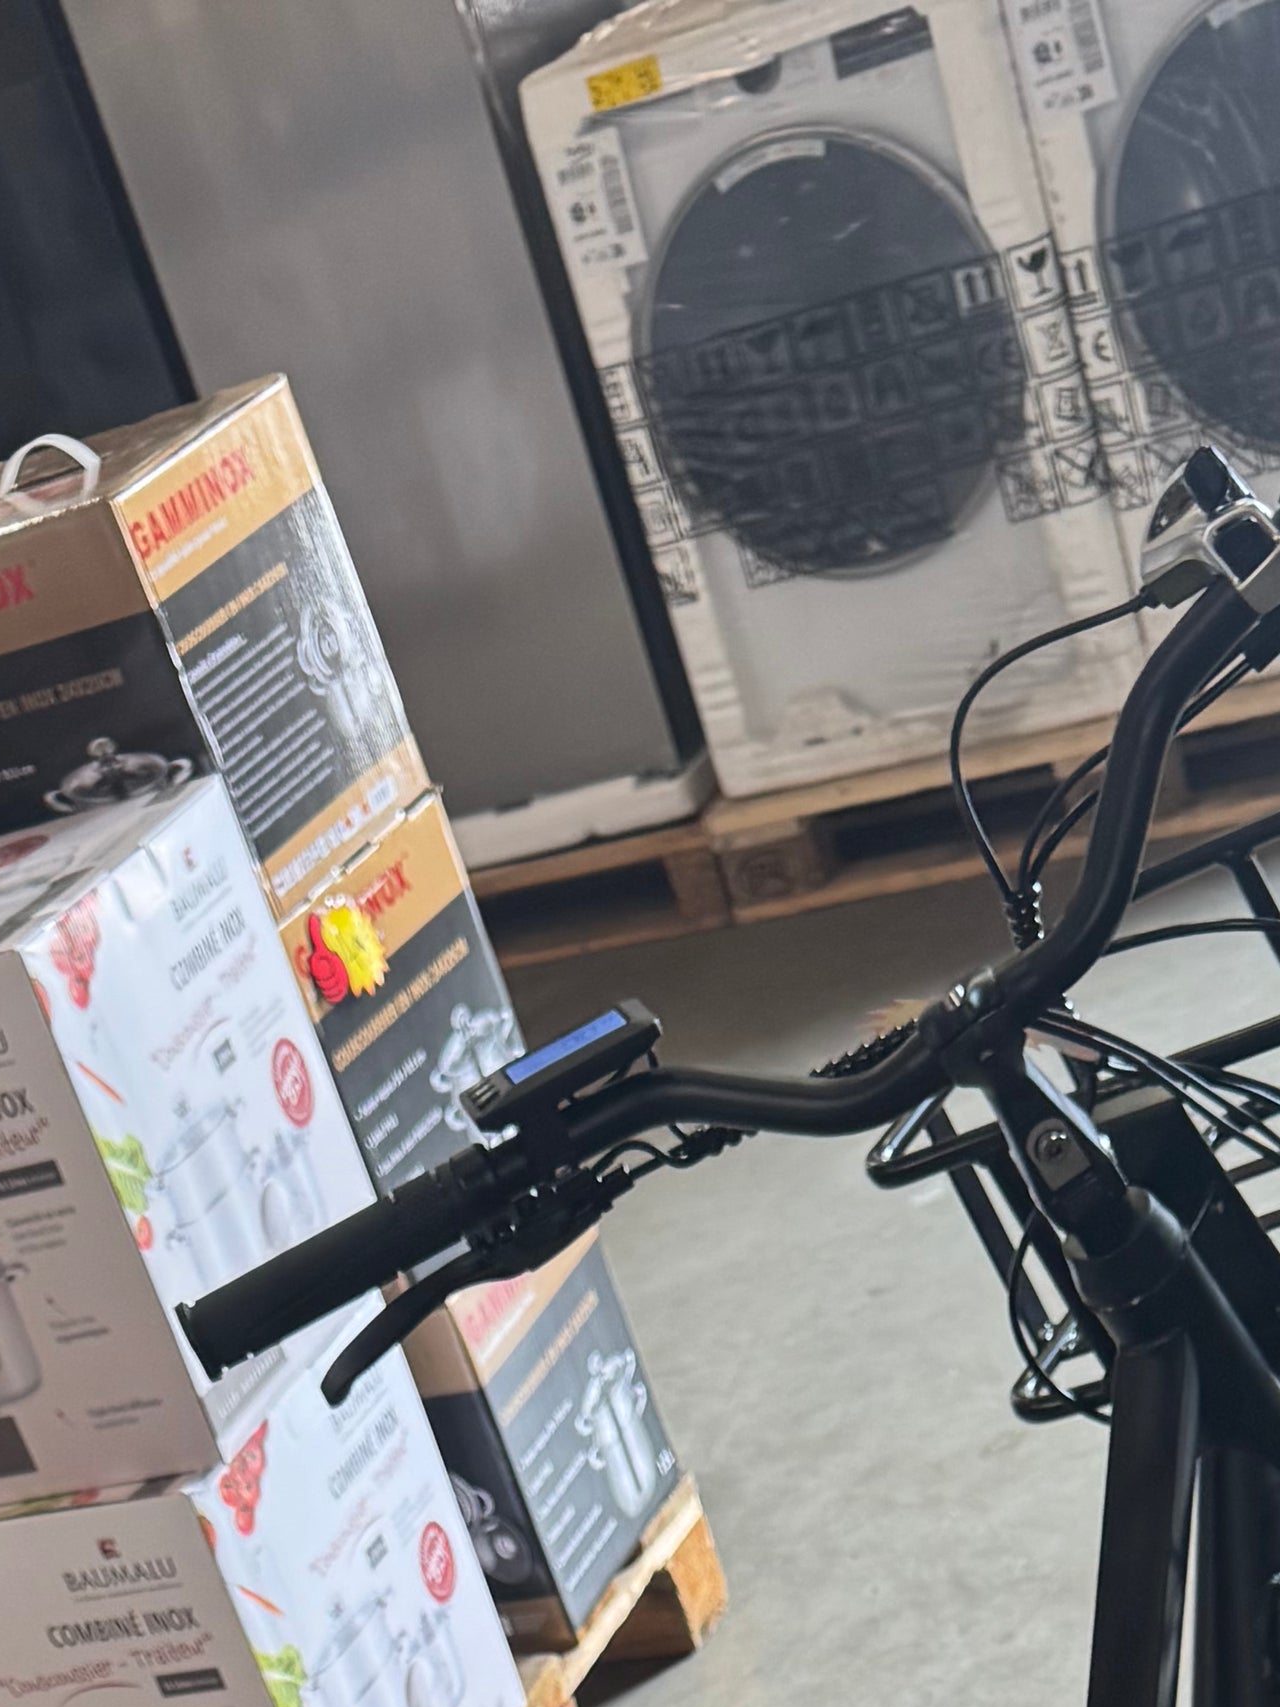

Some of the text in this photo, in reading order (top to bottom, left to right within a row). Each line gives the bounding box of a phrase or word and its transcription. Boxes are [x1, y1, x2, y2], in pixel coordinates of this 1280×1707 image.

[130, 447, 255, 559] GAMMINOX
[62, 1557, 178, 1594] BAUMALU
[47, 1606, 200, 1649] COMBINÉ INOX
